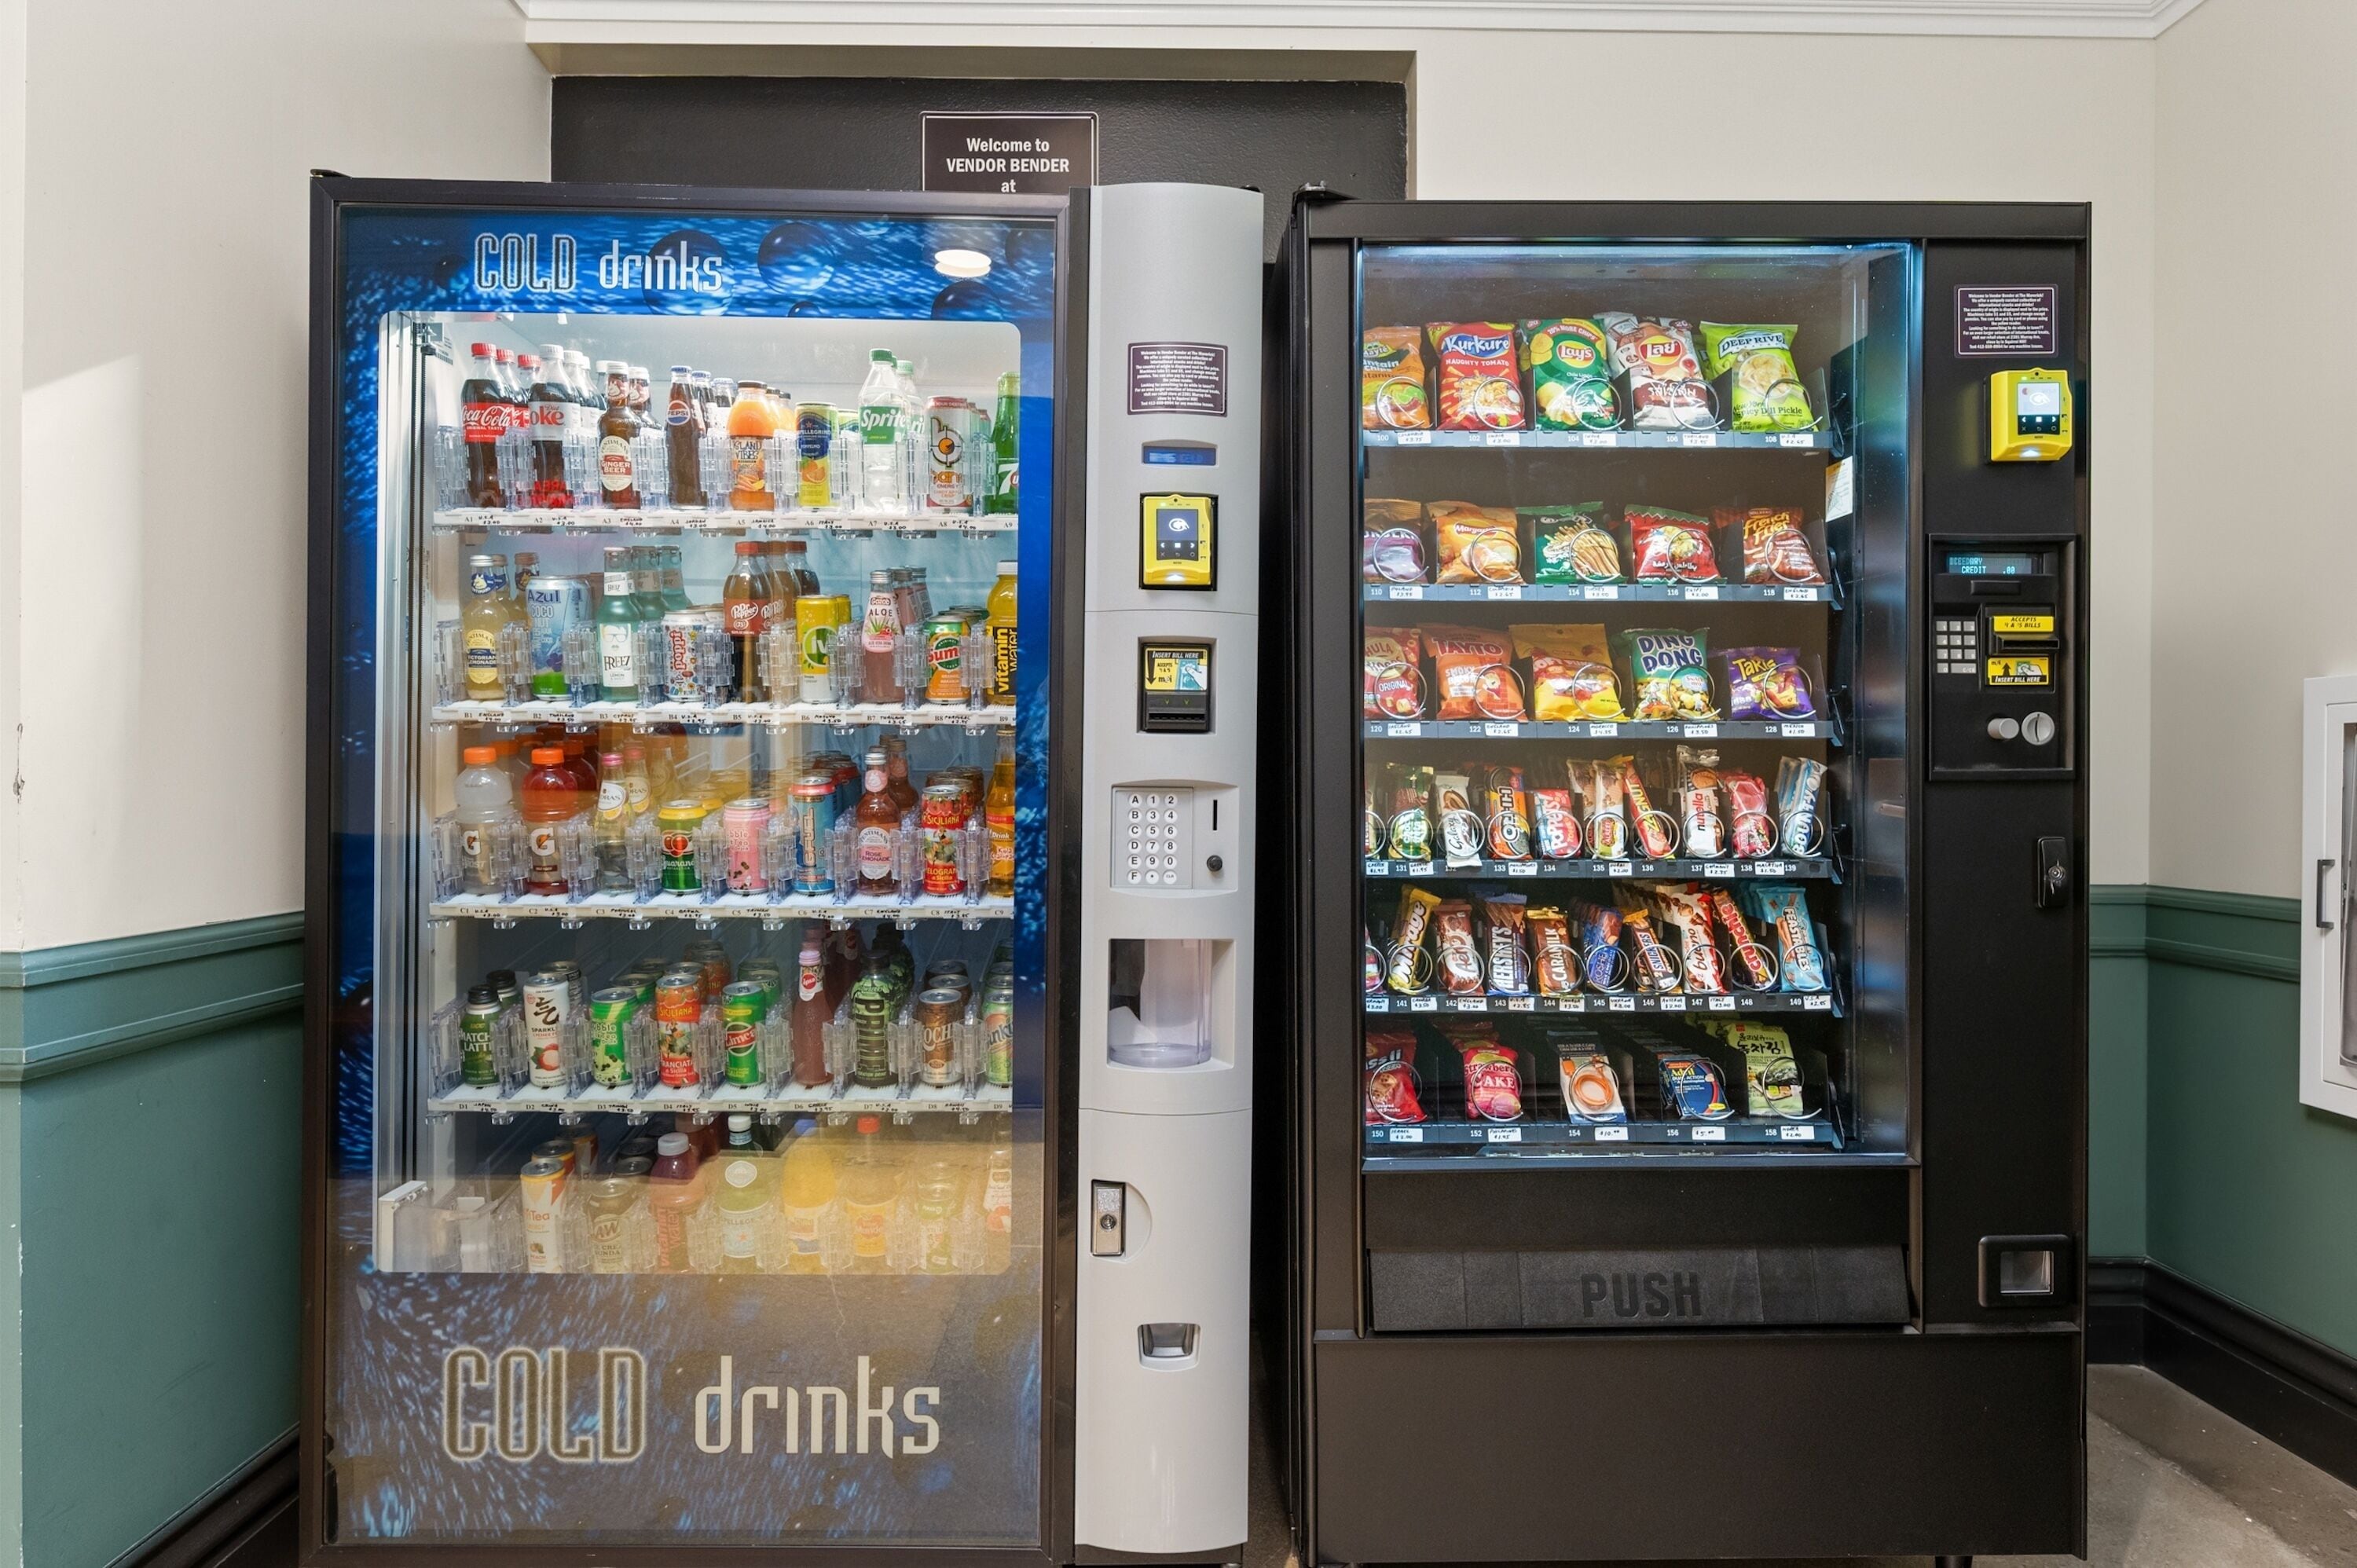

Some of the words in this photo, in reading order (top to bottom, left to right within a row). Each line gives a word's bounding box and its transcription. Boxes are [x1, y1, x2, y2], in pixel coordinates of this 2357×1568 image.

[966, 137, 1031, 152] Welcome
[1035, 137, 1050, 152] to
[946, 158, 1006, 173] VENDOR
[1010, 158, 1069, 173] BENDER
[1001, 179, 1016, 192] at
[475, 232, 577, 293] COLD
[599, 240, 723, 293] drinks
[1441, 333, 1509, 356] Kurkure
[1561, 346, 1594, 361] Lay's
[1721, 336, 1752, 353] DEEP
[530, 406, 565, 426] oke
[861, 408, 906, 430] Sprite
[733, 439, 762, 450] ISLAND
[735, 449, 758, 460] VIBES
[1744, 512, 1790, 539] french
[1754, 521, 1790, 544] fries
[1961, 566, 1987, 574] CREDIT
[528, 589, 562, 603] Azul
[531, 605, 554, 617] COCO
[869, 608, 893, 617] ALOE
[669, 631, 687, 671] poppi
[1366, 643, 1393, 657] HULA
[1434, 637, 1502, 655] TAYTO
[1637, 635, 1694, 654] DING
[604, 655, 632, 672] FREEZ
[994, 628, 1009, 693] vitamin
[1641, 648, 1703, 674] DONG
[1733, 657, 1777, 681] Takis
[1446, 667, 1474, 676] SMOKY
[1379, 680, 1413, 693] ORIGINAL
[1693, 793, 1705, 831] nutella
[1446, 815, 1463, 850] Galaxy
[1792, 790, 1816, 855] BOUNTY
[463, 830, 481, 855] G
[530, 828, 555, 856] G
[1392, 901, 1426, 984] Mirage
[1721, 903, 1762, 972] crunchie
[1783, 907, 1812, 973] FEASTABLES
[1545, 928, 1567, 981] CARAMILK
[1639, 933, 1664, 971] SNICKERS
[1692, 928, 1707, 970] bueno
[658, 1006, 692, 1017] SICILIANA
[725, 1030, 756, 1047] Limca
[1738, 1040, 1782, 1055] 녹차김
[1471, 1073, 1516, 1089] CAKE
[1671, 1068, 1694, 1076] Advil
[1581, 1272, 1702, 1318] PUSH
[443, 1345, 646, 1463] COLD
[695, 1355, 940, 1459] drinks
